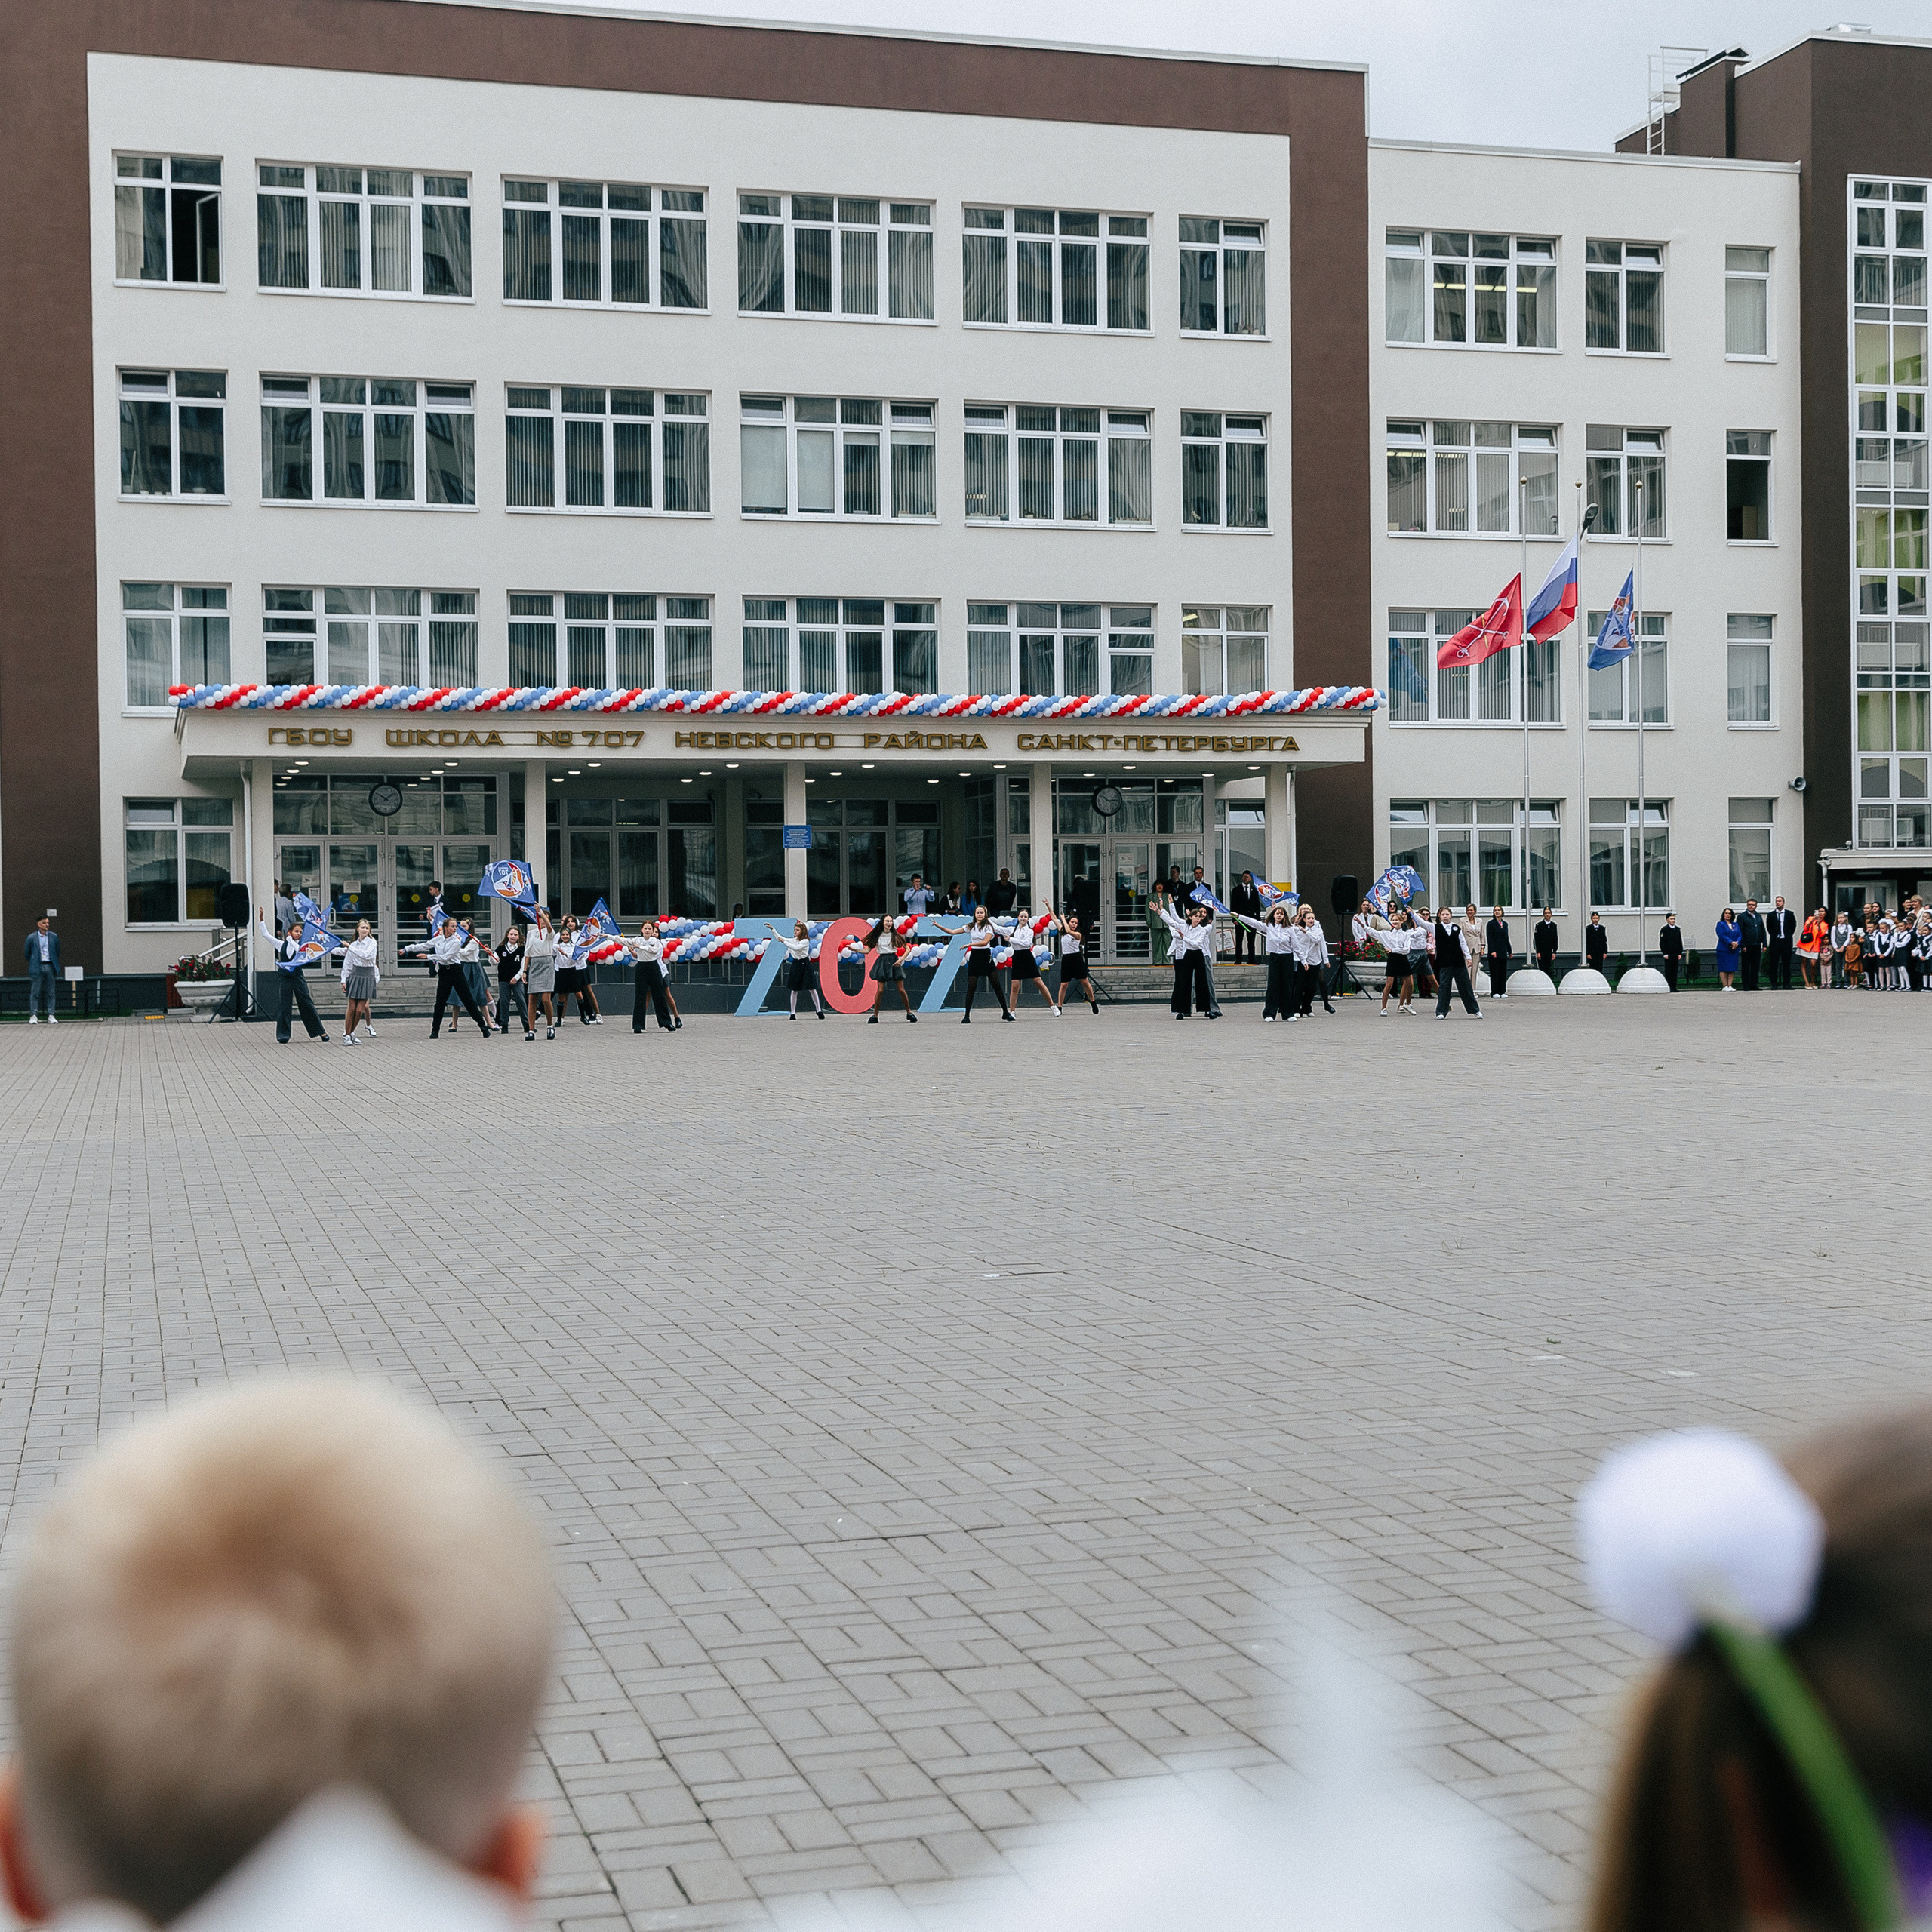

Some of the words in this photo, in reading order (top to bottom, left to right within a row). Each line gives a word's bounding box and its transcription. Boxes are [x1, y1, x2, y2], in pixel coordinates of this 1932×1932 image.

[268, 728, 352, 746] ГБОУ
[386, 728, 503, 746] ШКОЛА
[675, 731, 835, 748] НЕВСКОГО
[863, 731, 988, 749] РАЙОНА
[1017, 734, 1300, 752] САНКТ-ПЕТЕРБУРГА
[734, 917, 974, 1016] 707
